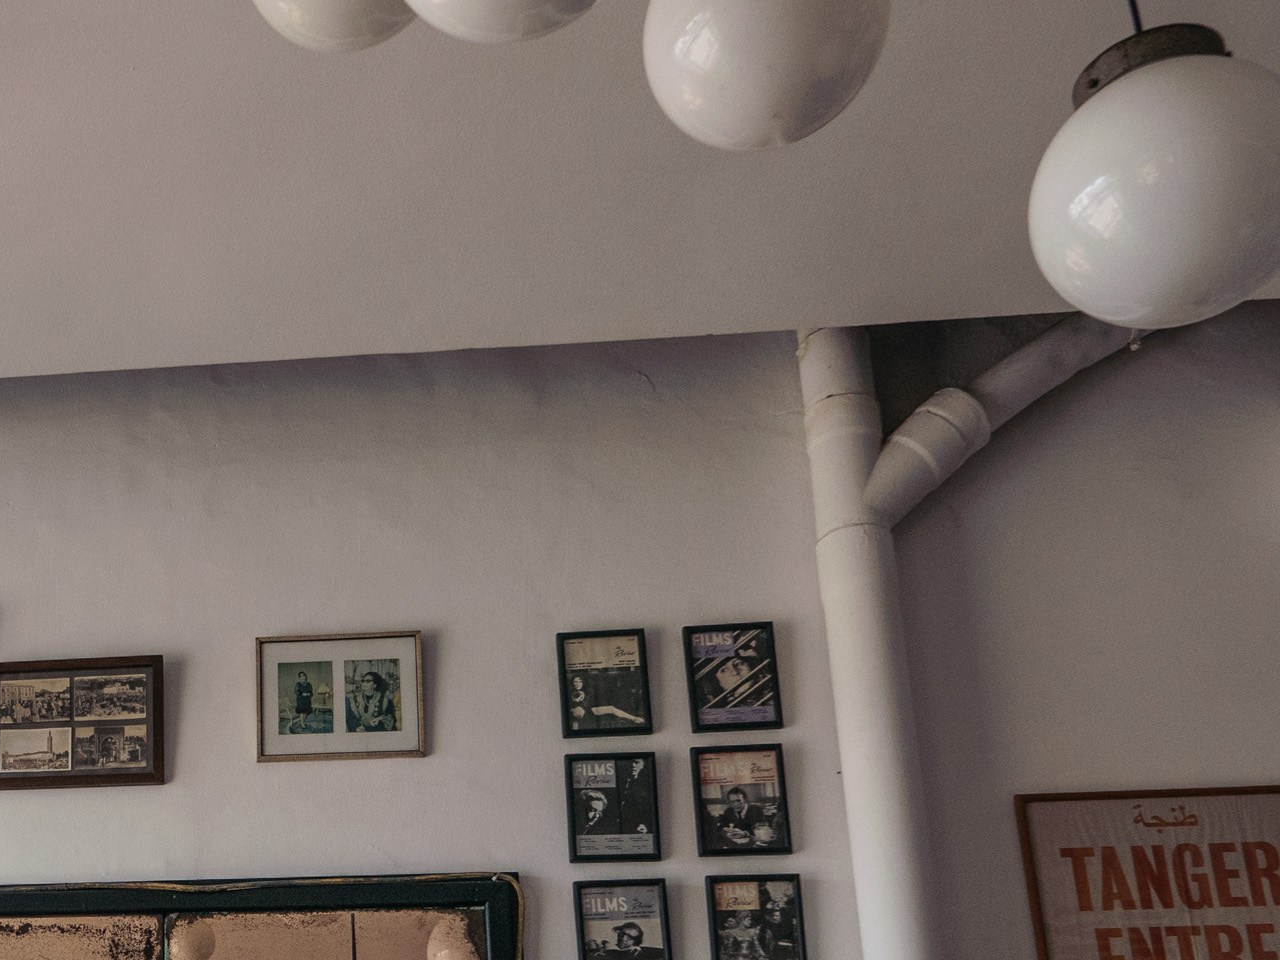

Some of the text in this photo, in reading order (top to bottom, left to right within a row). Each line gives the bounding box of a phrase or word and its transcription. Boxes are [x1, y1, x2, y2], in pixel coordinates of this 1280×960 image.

[693, 632, 733, 647] FILMS
[577, 763, 614, 776] FILMS
[1133, 804, 1199, 833] طنجة
[1059, 841, 1280, 912] TANGER
[584, 897, 628, 914] FILMS
